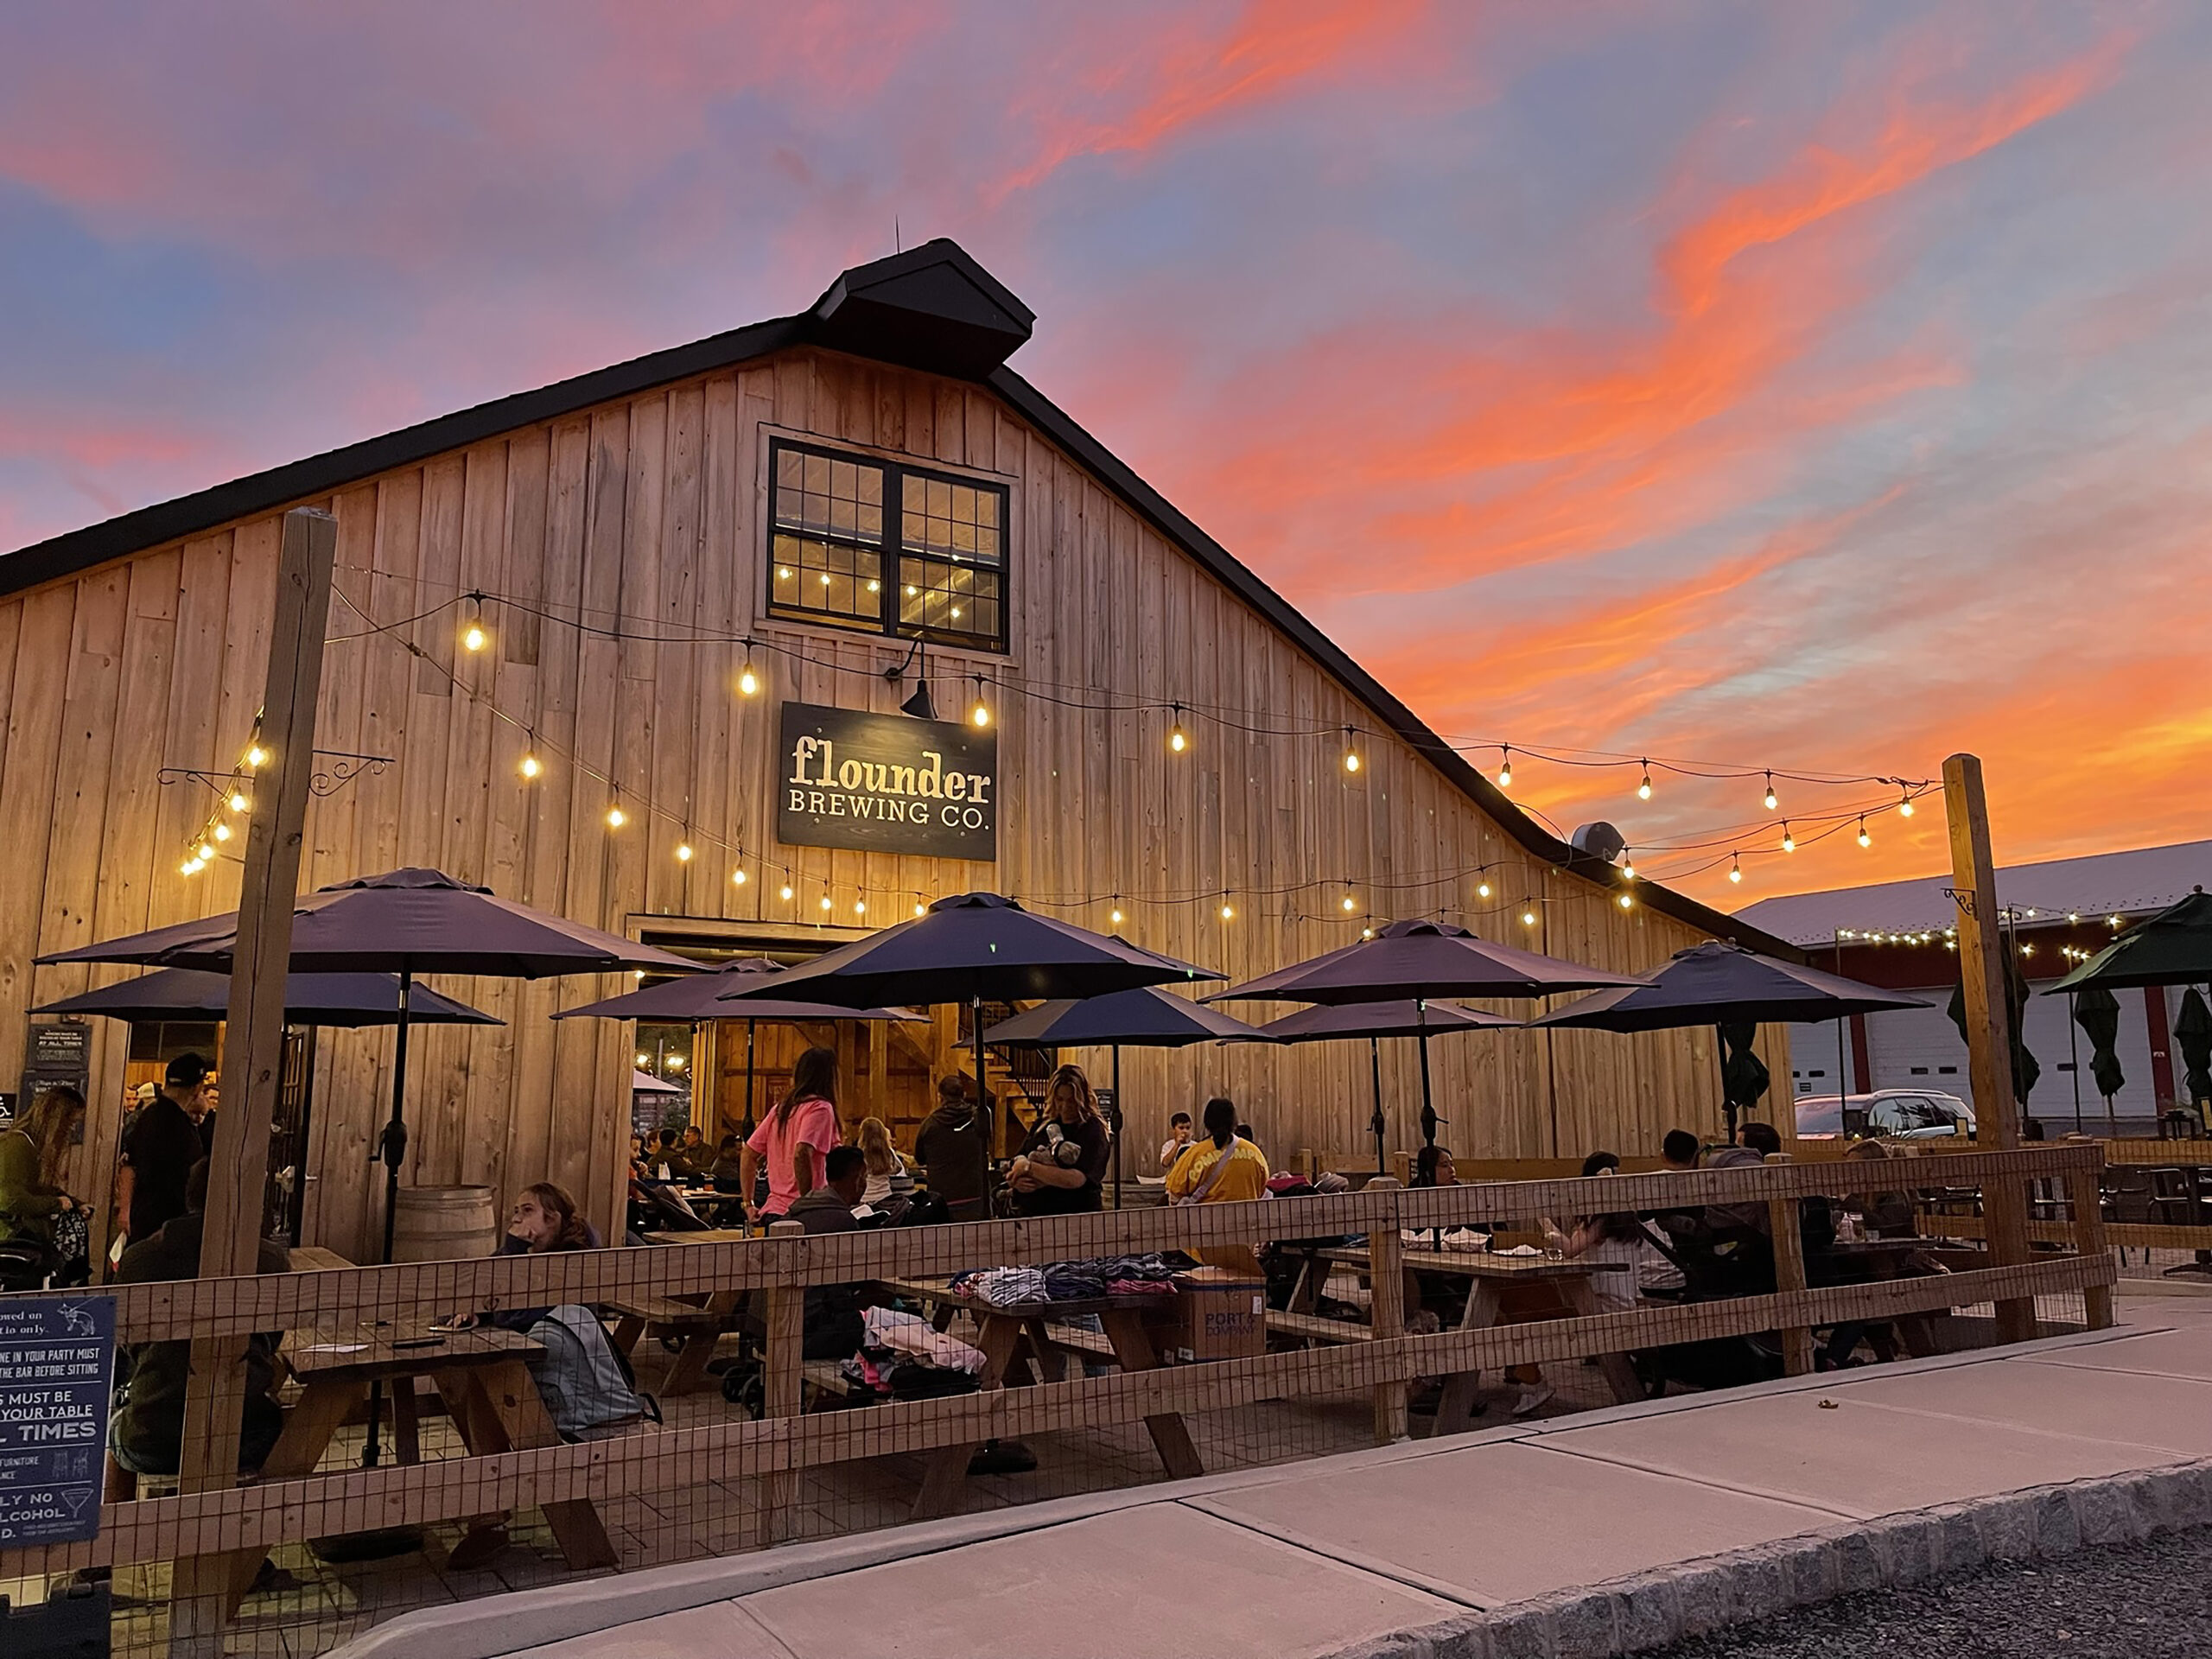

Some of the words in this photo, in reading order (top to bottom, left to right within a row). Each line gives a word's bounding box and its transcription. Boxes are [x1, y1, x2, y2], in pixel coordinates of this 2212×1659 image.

[789, 735, 991, 804] flounder
[788, 789, 929, 825] BREWING
[941, 805, 989, 830] CO.
[1206, 1313, 1245, 1325] PORT
[13, 1351, 22, 1363] IN
[24, 1351, 46, 1363] YOUR
[48, 1349, 75, 1361] PARTY
[77, 1348, 100, 1360] MUST
[16, 1366, 33, 1378] BAR
[35, 1365, 66, 1377] BEFORE
[67, 1363, 99, 1376] SITTING
[9, 1391, 50, 1405] MUST
[54, 1390, 73, 1402] BE
[2, 1407, 44, 1421] YOUR
[48, 1404, 92, 1418] TABLE
[18, 1421, 96, 1441] TIMES
[30, 1493, 53, 1504] NO
